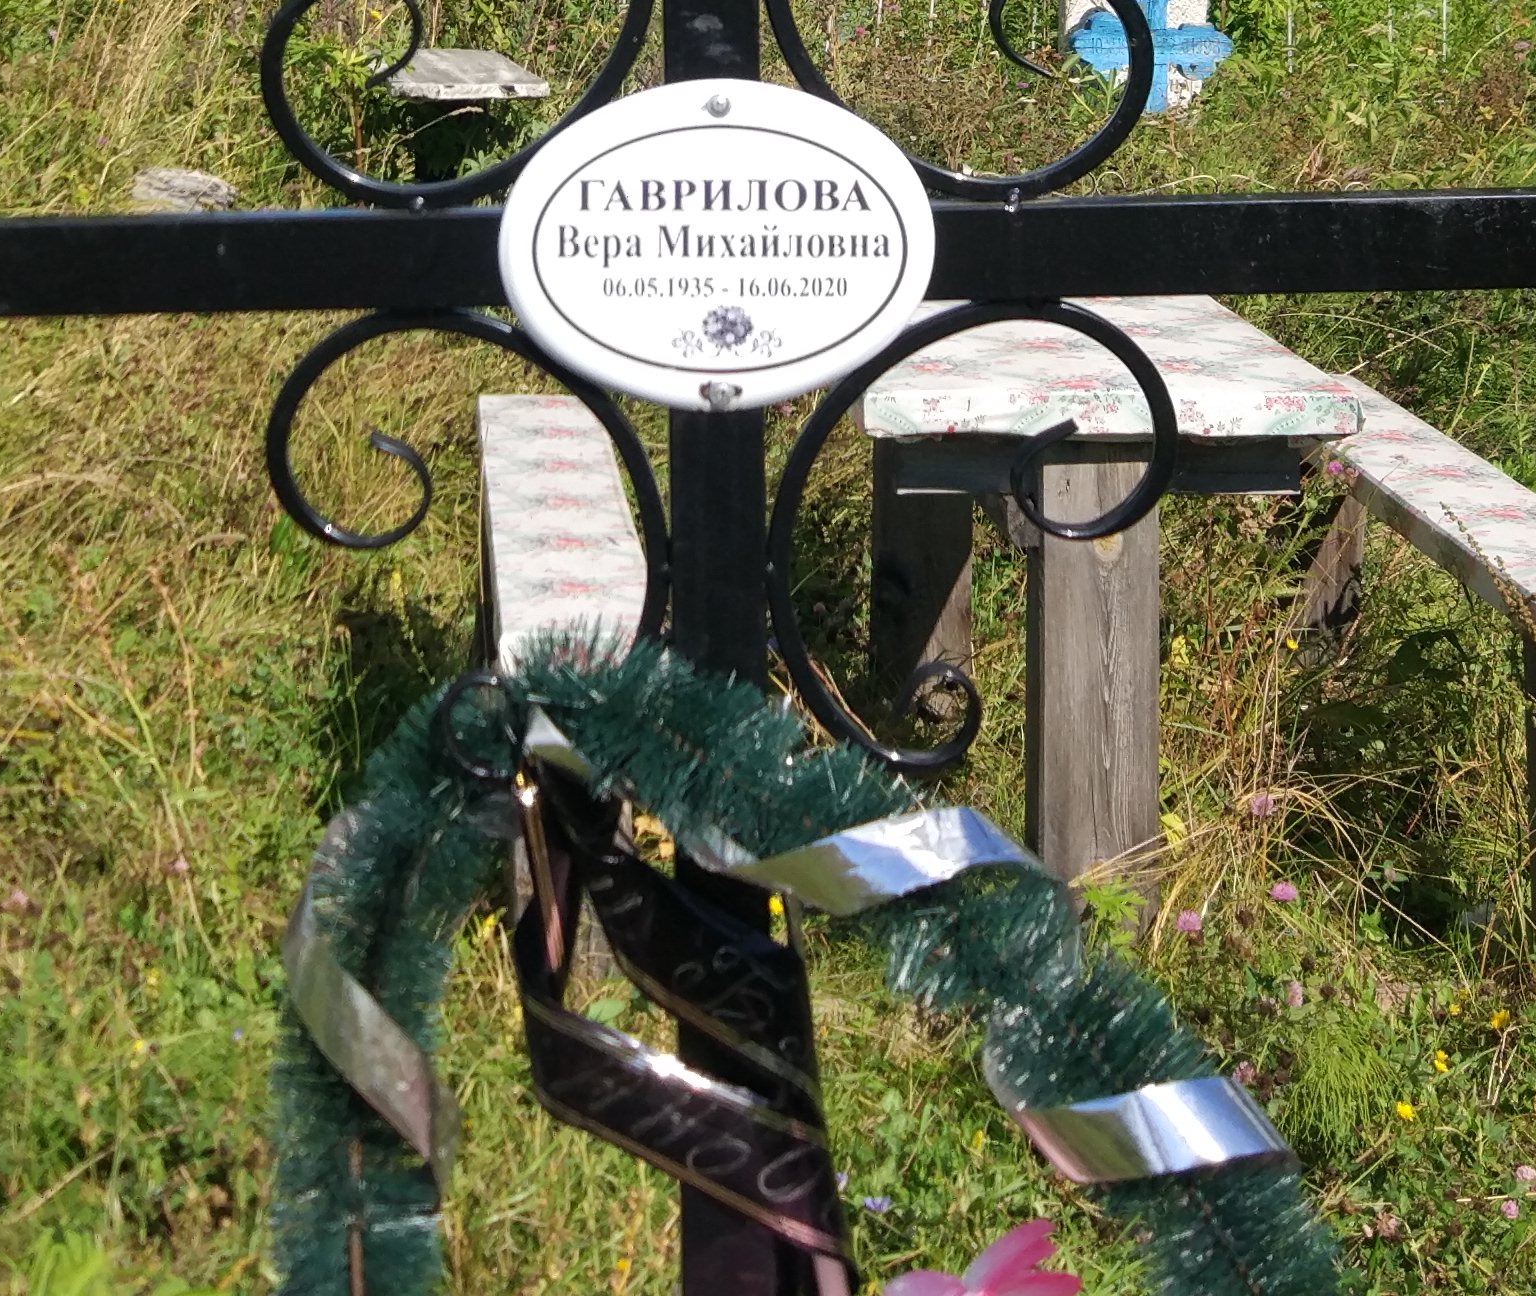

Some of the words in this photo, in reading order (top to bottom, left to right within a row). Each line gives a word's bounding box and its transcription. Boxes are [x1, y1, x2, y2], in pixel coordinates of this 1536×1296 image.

[580, 178, 872, 212] ГАВРИЛОВА
[558, 224, 642, 268] Вера
[657, 224, 890, 259] Михайловна
[603, 276, 714, 298] 06.05.1935
[739, 276, 848, 298] 16.06.2020
